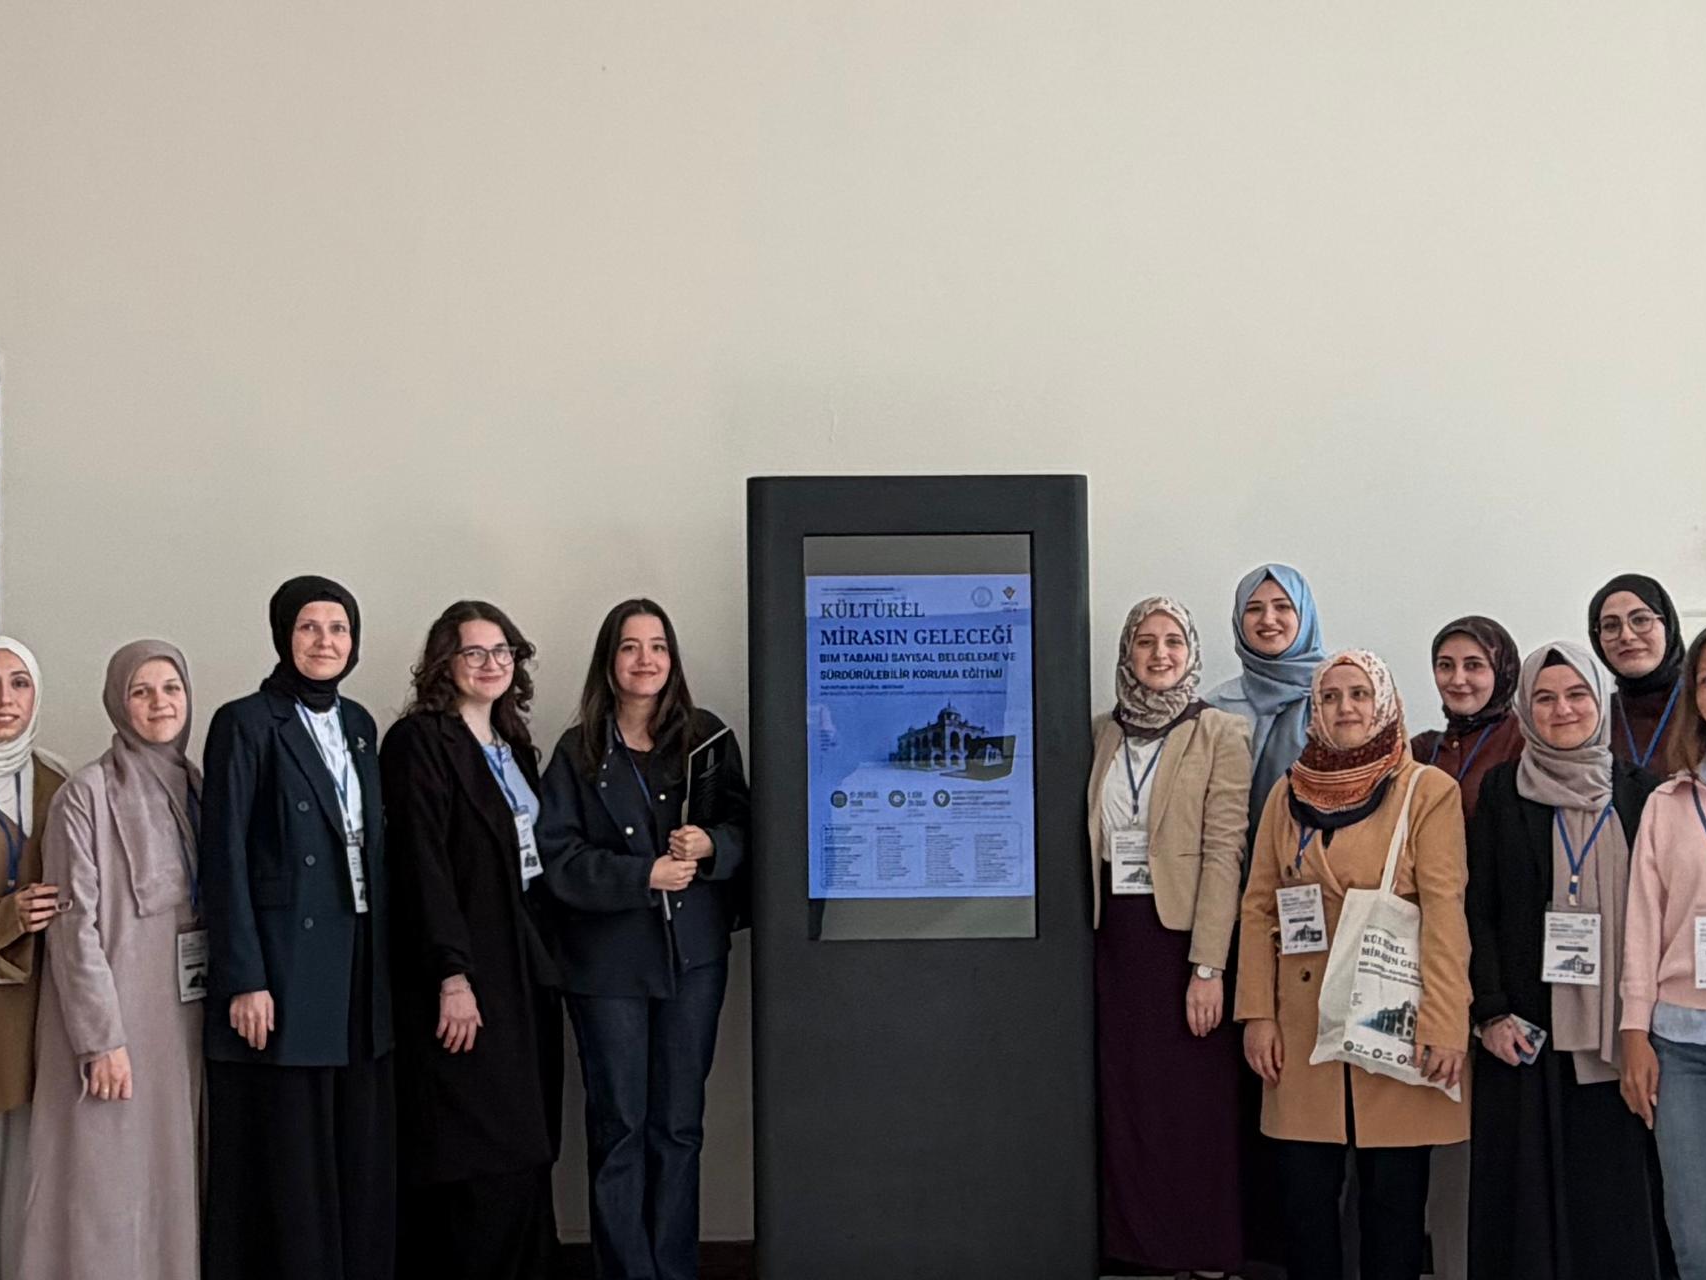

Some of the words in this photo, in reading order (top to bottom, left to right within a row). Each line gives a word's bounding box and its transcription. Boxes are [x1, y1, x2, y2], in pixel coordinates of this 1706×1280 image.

[820, 600, 925, 619] KÜLTÜREL
[820, 626, 908, 646] MİRASIN
[914, 624, 1013, 645] GELECEĞİ
[891, 652, 936, 663] SAYISAL
[938, 652, 1000, 662] BELGELEME
[1002, 652, 1017, 661] VE
[820, 668, 910, 680] SÜRDÜRÜLEBİLİR
[913, 669, 959, 679] KORUMA
[962, 667, 1003, 679] EĞİTİMİ
